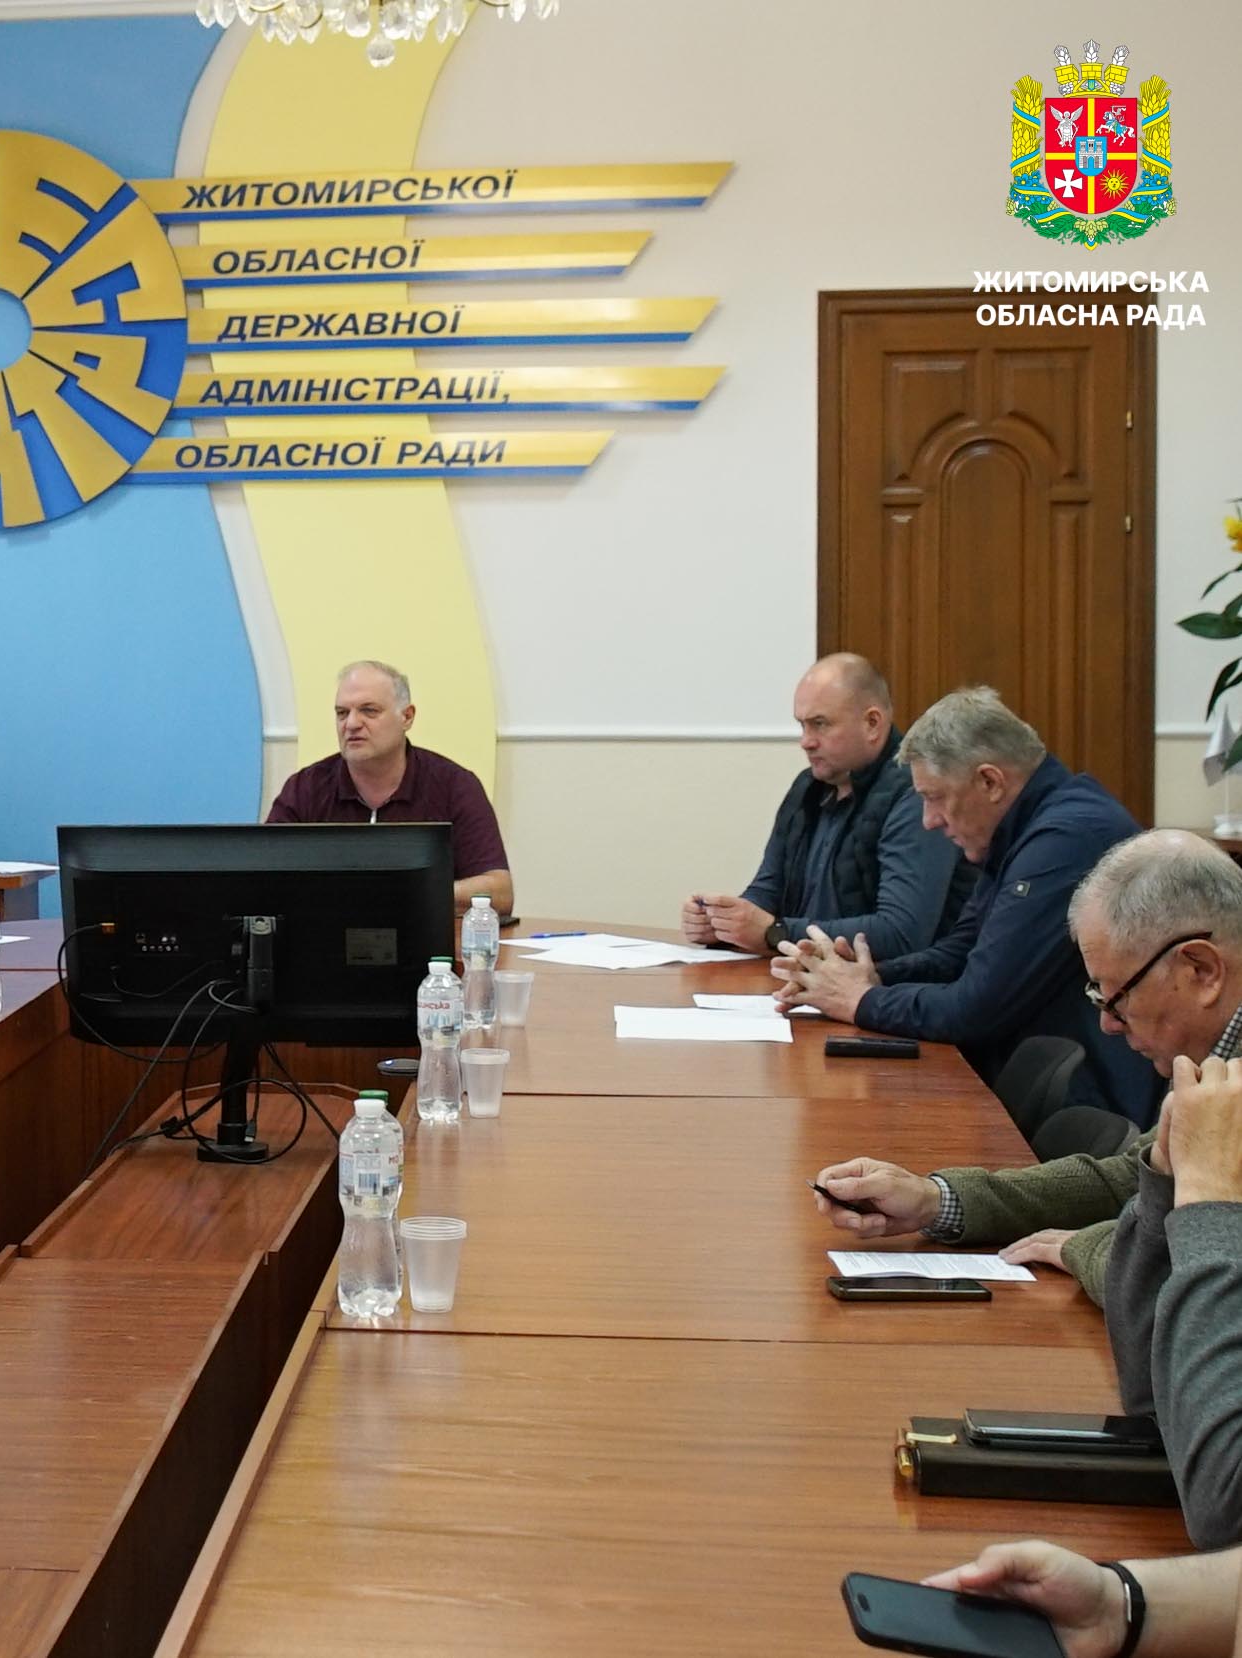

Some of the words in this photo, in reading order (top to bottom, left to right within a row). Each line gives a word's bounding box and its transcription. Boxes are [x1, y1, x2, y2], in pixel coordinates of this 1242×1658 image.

[182, 169, 518, 209] ЖИТОМИРСЬКОЇ
[212, 239, 425, 275] ОБЛАСНОЇ
[217, 304, 465, 342] ДЕРЖАВНОЇ
[199, 369, 510, 406] АДМІНІСТРАЦІЇ,
[175, 436, 387, 469] ОБЛАСНОЇ
[396, 440, 507, 468] РАДИ
